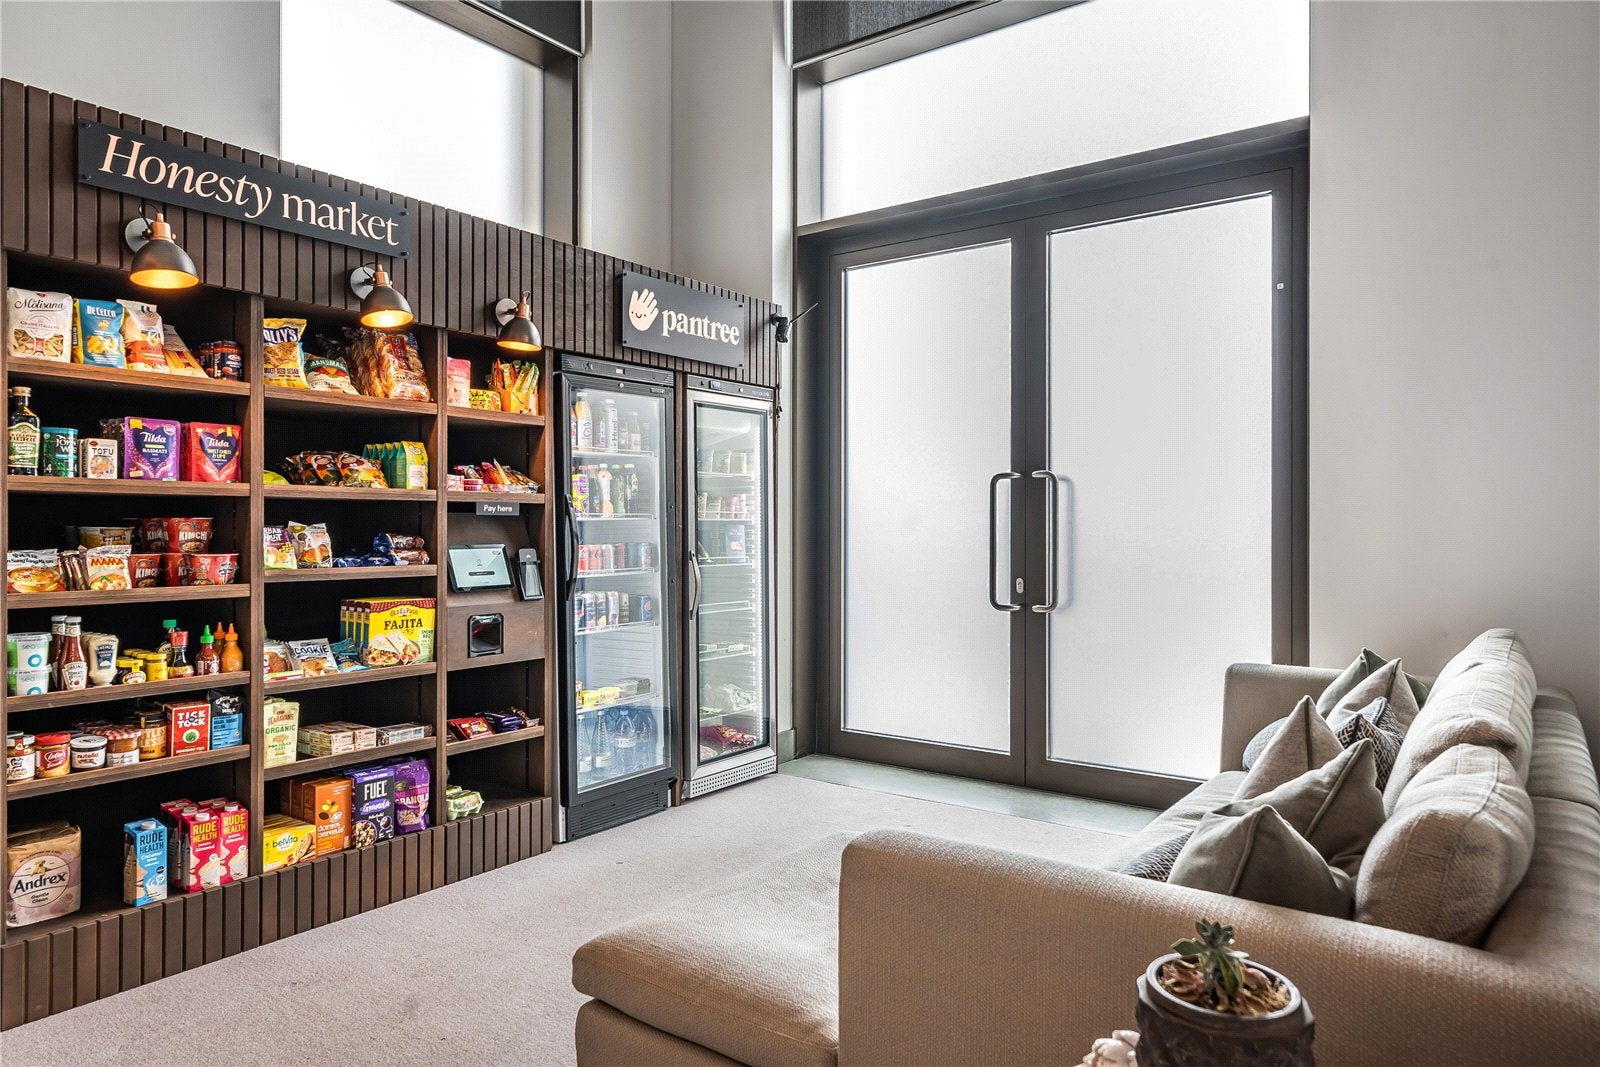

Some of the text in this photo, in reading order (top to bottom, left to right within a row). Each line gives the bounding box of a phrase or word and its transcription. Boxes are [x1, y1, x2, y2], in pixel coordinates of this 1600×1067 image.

[98, 133, 399, 246] Honesty market
[661, 309, 740, 346] pantree
[140, 431, 167, 443] Tilda
[206, 436, 230, 447] Tilda
[91, 447, 114, 456] TOFU
[483, 504, 513, 514] Pay here
[178, 531, 208, 541] KIMCHI
[91, 557, 125, 567] MAMA
[383, 617, 423, 631] FAJITA
[294, 644, 329, 655] COOKIE
[177, 709, 206, 720] TICK
[177, 718, 206, 729] TOCK
[265, 724, 297, 735] ORGANIC
[77, 752, 100, 760] nutella
[363, 780, 388, 801] FUEL
[394, 792, 429, 806] GRANOLA
[362, 800, 392, 813] Granola
[223, 813, 246, 827] RUDE
[192, 820, 218, 836] RUDE
[223, 823, 246, 836] HEALTH
[317, 826, 345, 839] cereals
[139, 830, 164, 847] RUDE
[192, 831, 218, 844] HEALTH
[272, 834, 299, 848] belVita
[139, 841, 164, 855] HEALTH
[194, 844, 216, 853] Almond
[13, 872, 68, 894] Andrex
